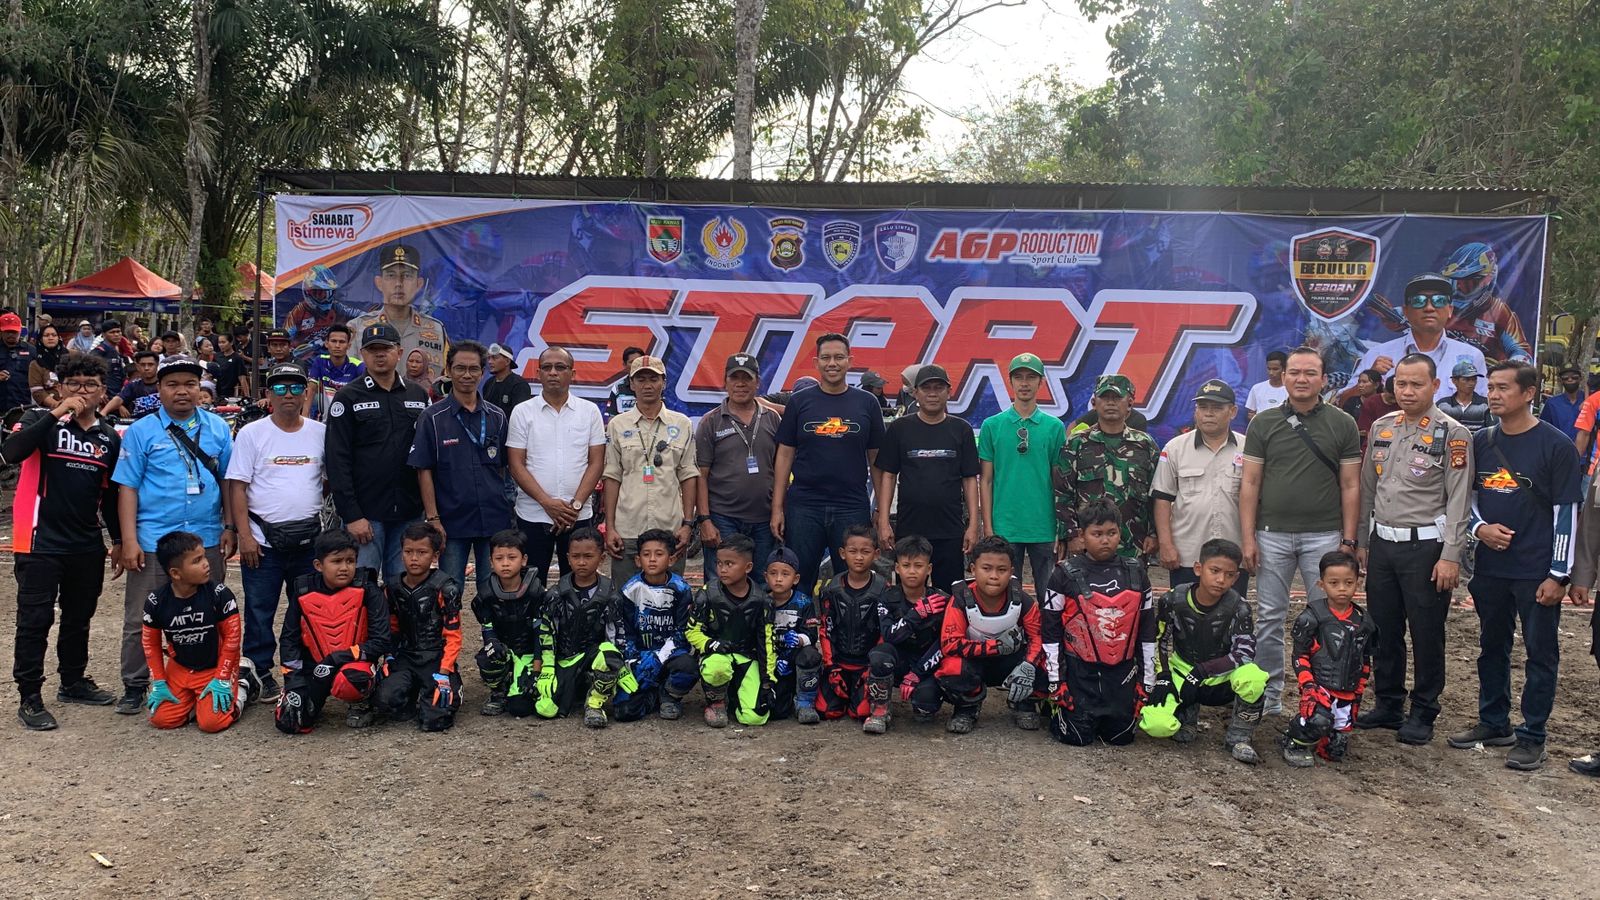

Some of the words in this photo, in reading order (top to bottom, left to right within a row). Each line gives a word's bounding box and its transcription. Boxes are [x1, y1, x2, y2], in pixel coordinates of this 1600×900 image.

[312, 214, 354, 226] SAHABAT
[290, 223, 354, 239] istimewa
[706, 258, 741, 268] INDONESIA
[1031, 254, 1055, 264] Sport
[1057, 255, 1078, 264] Club
[1300, 262, 1367, 275] BEDULUR
[518, 281, 1253, 422] START
[1411, 443, 1434, 455] POL
[923, 649, 943, 672] FXR
